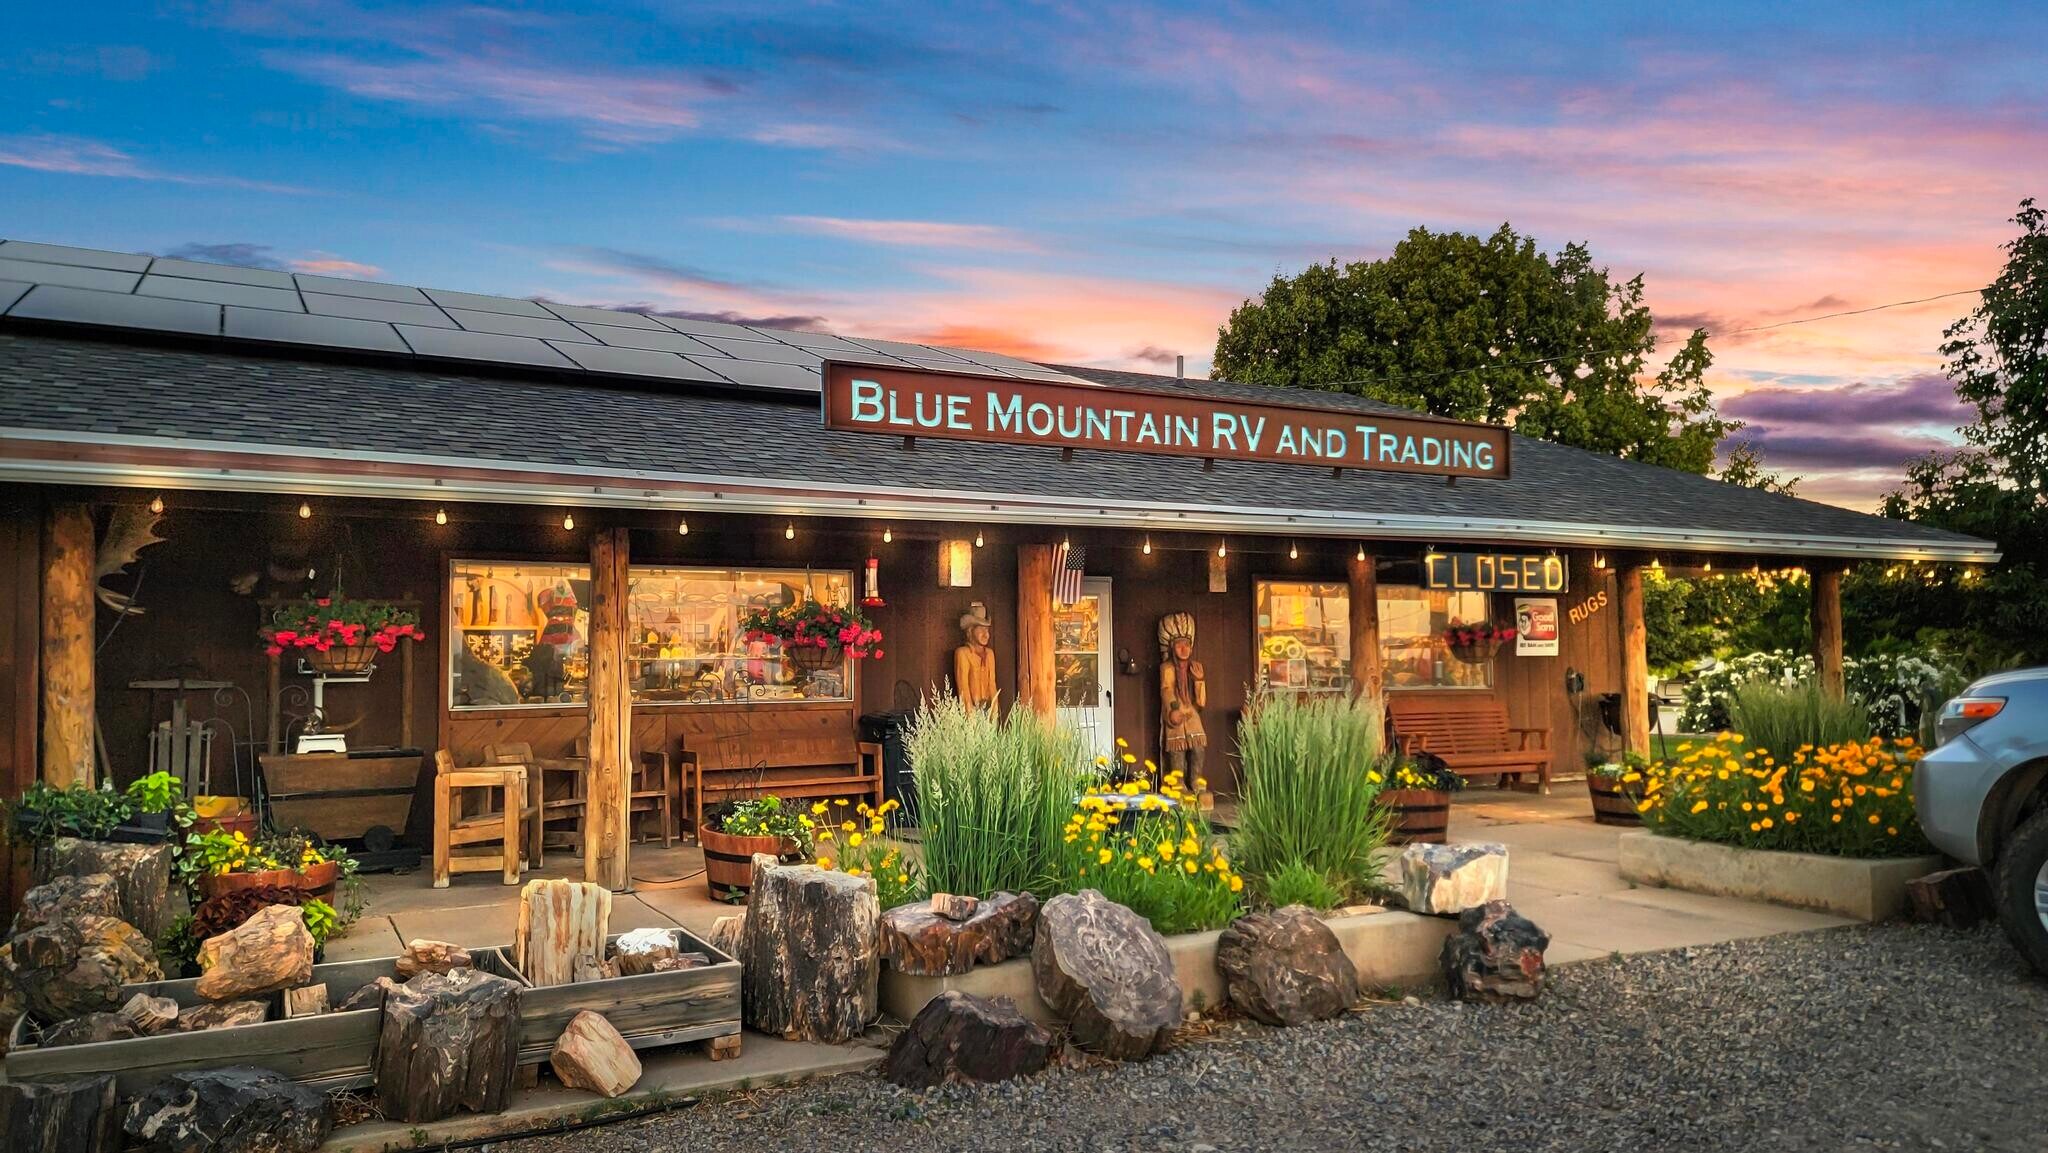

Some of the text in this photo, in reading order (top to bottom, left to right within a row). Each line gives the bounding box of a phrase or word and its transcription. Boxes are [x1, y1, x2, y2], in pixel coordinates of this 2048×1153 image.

[851, 379, 1495, 471] BLUE MOUNTAIN RV AND TRADING
[1424, 553, 1564, 591] CLOSED
[1532, 611, 1555, 622] Good
[1568, 590, 1608, 625] RUGS
[1535, 621, 1555, 632] Sam
